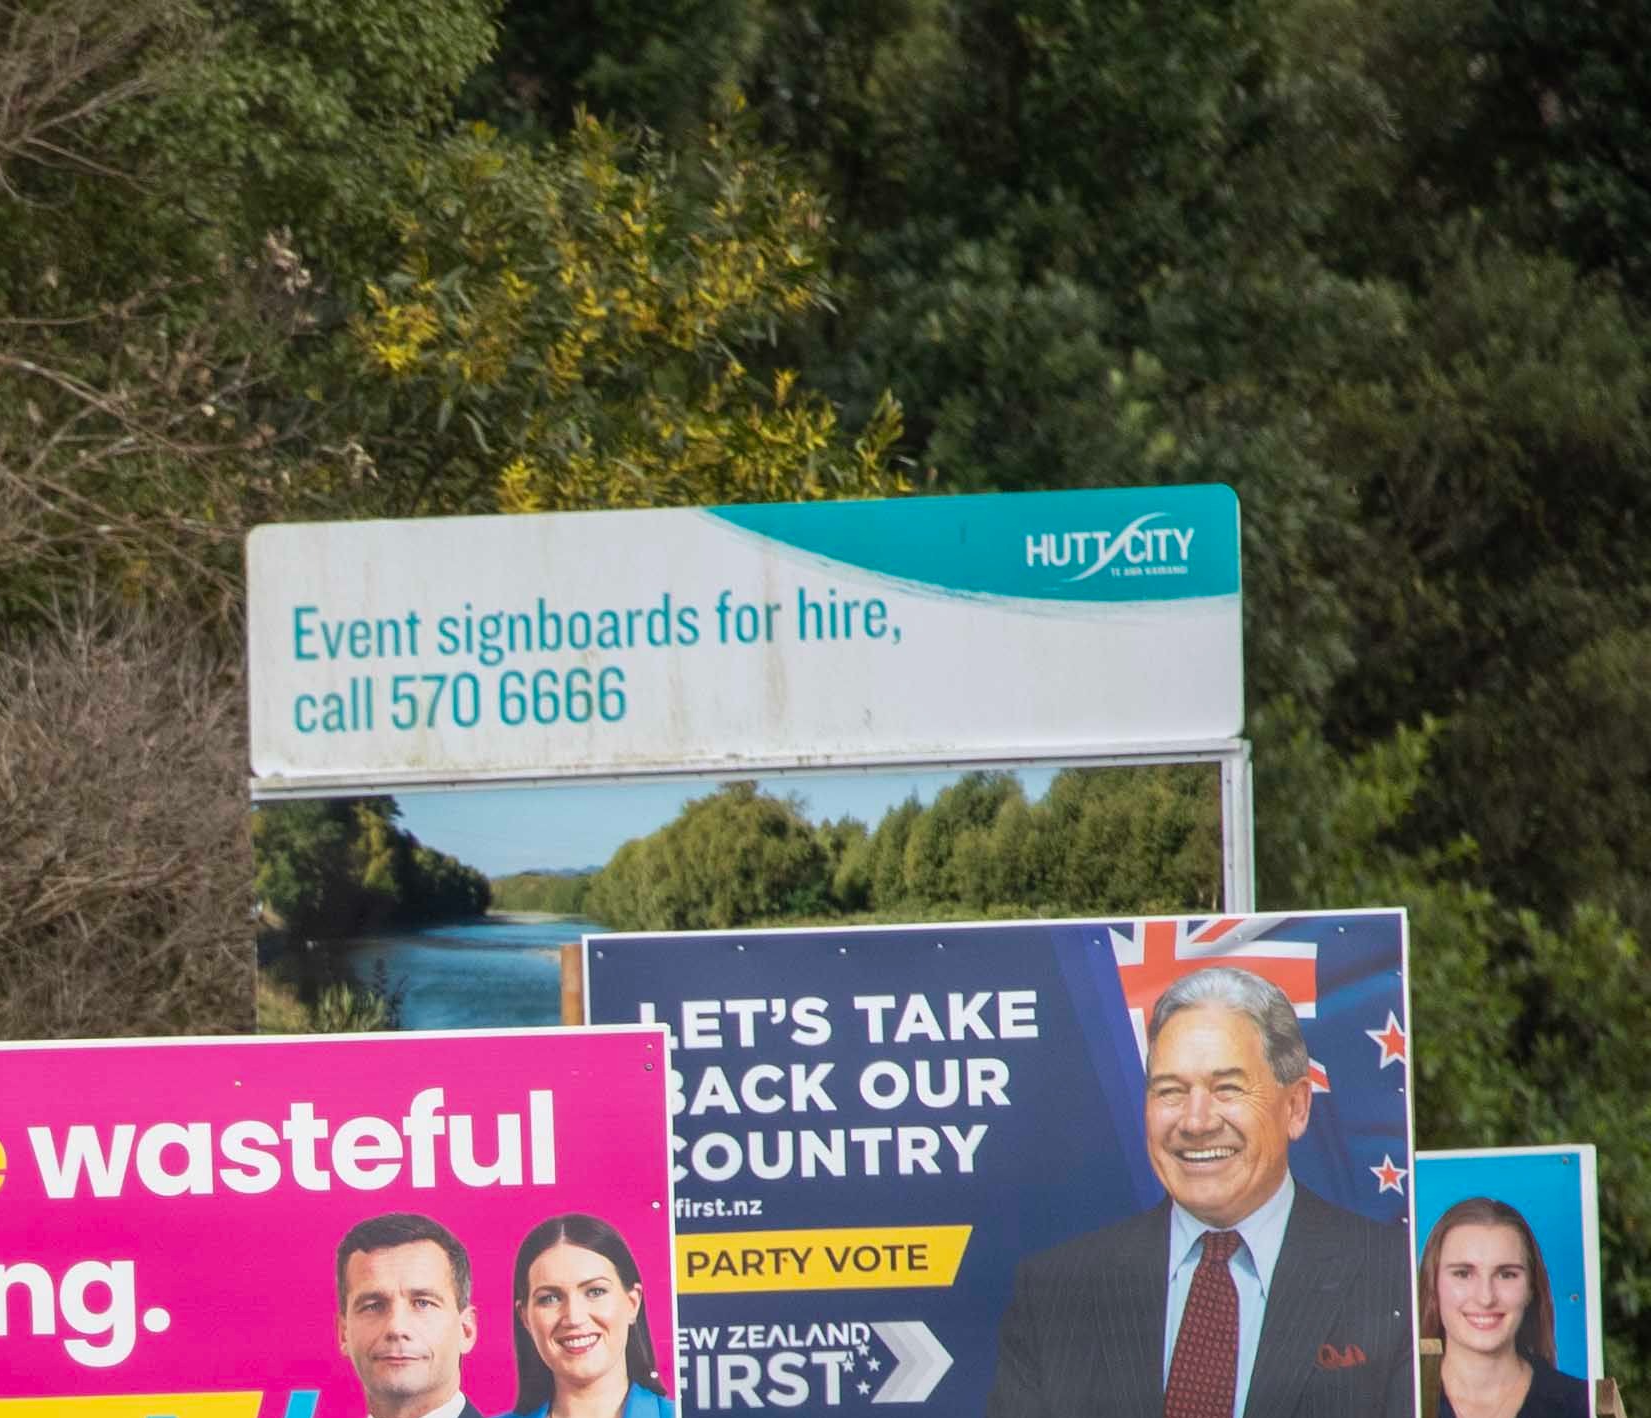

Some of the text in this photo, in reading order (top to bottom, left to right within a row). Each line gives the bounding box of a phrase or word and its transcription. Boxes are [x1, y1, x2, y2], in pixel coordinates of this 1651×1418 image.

[1025, 527, 1195, 567] HUTT CITY
[294, 588, 903, 666] Event signboards for hire,
[295, 667, 626, 733] call 570 6666
[854, 991, 1038, 1043] TAKE
[860, 1058, 1010, 1109] OUR
[28, 1094, 555, 1200] wasteful
[687, 1244, 928, 1277] PARTY VOTE
[677, 1322, 870, 1350] EW ZEALAND
